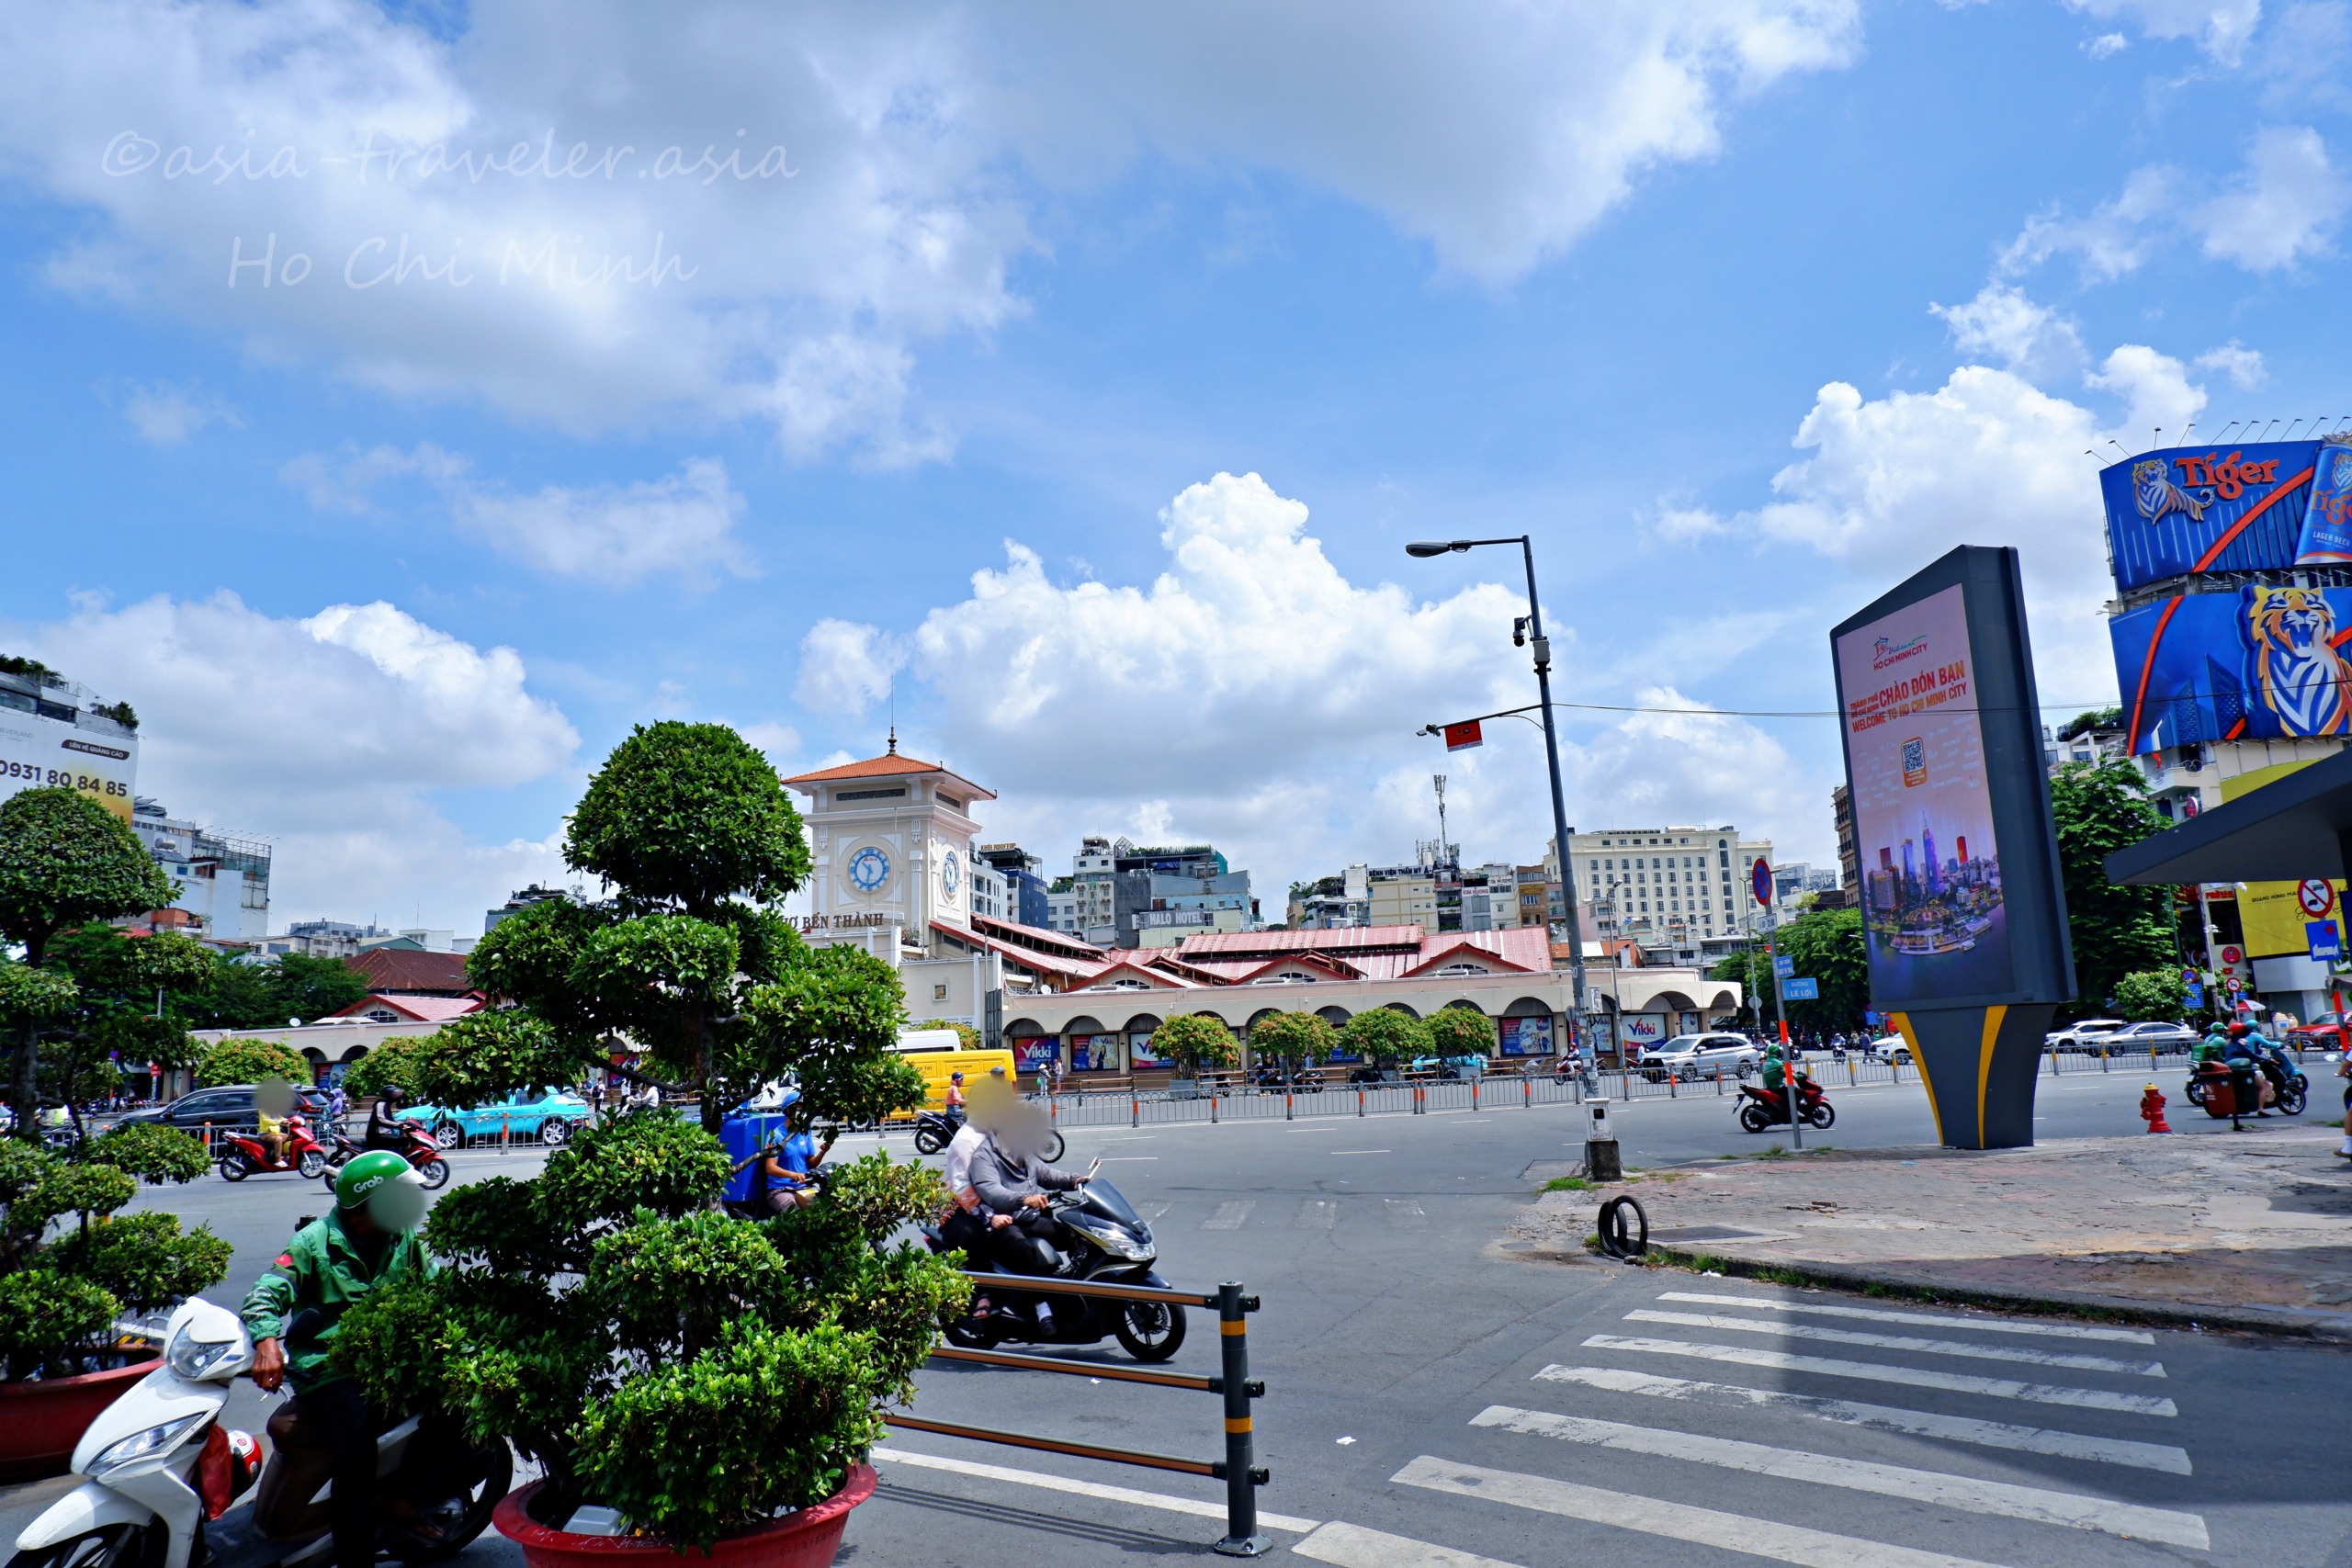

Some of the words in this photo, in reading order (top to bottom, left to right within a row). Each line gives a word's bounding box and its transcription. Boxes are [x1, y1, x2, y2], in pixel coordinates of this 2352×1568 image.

[2176, 450, 2279, 500] Tiger
[2312, 530, 2333, 542] LAGER
[1873, 660, 1883, 671] HO
[1883, 657, 1895, 667] CHI
[1894, 650, 1912, 662] MINH
[1912, 643, 1928, 656] CITY
[1879, 681, 1909, 707] CHÀO
[1911, 670, 1937, 696] ĐÓN
[1938, 660, 1966, 686] BẠN
[1851, 712, 1886, 733] WELCOME
[1886, 707, 1898, 721] TO
[1898, 703, 1910, 717] HO
[1911, 698, 1925, 713] CHI
[1926, 689, 1947, 707] MINH
[1948, 682, 1967, 700] CITY
[69, 740, 81, 750] LIÊN
[82, 743, 89, 751] HỆ
[89, 744, 110, 755] QUẢNG
[110, 750, 124, 758] CÁO
[0, 759, 42, 782] 0931
[47, 769, 73, 787] 80
[77, 775, 101, 793] 84
[105, 780, 128, 797] 85
[2251, 895, 2269, 903] QUANG
[781, 915, 798, 930] HỢ
[802, 911, 830, 930] BẾN
[833, 911, 884, 929] THÀNH
[1149, 912, 1172, 926] HALO
[1175, 910, 1203, 924] HOTEL
[1790, 988, 1799, 998] LÊ
[1801, 988, 1813, 998] LỢI
[1627, 1017, 1657, 1036] Vikki
[1021, 1040, 1052, 1058] Vikki
[353, 1175, 384, 1193] Grab
